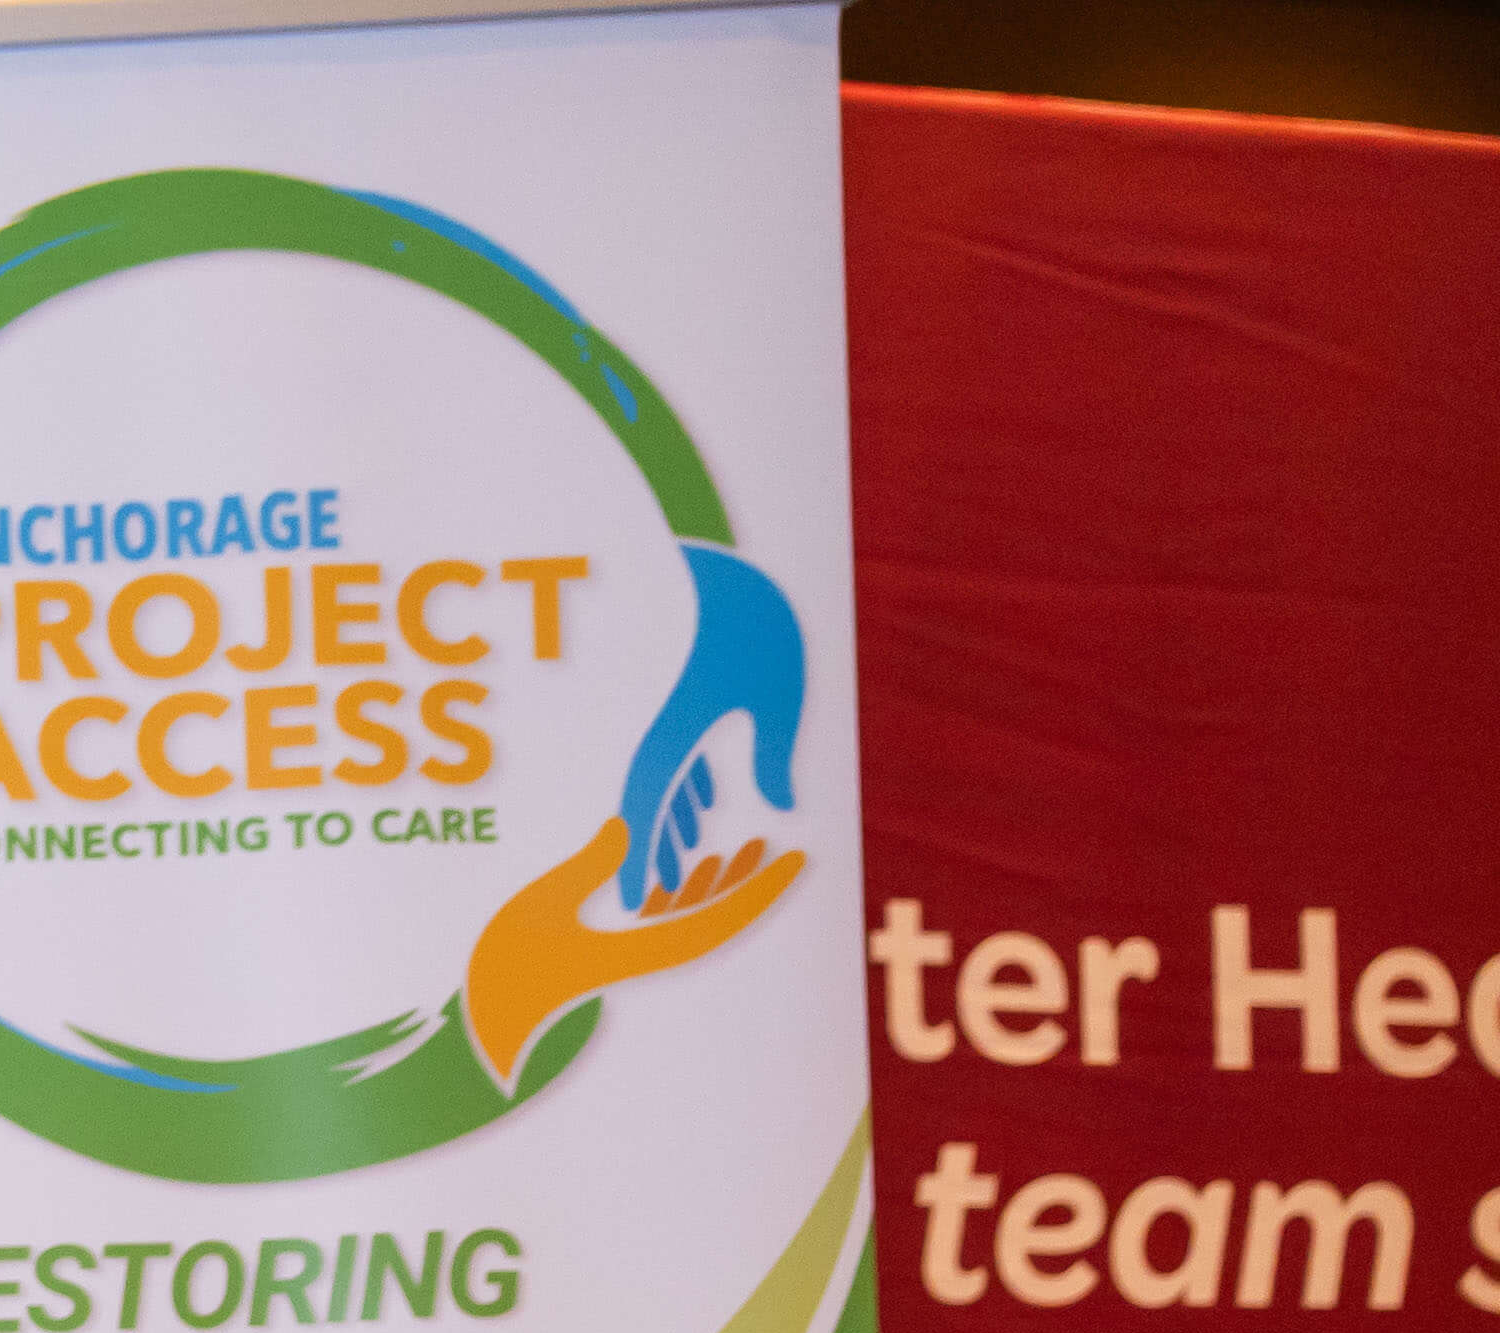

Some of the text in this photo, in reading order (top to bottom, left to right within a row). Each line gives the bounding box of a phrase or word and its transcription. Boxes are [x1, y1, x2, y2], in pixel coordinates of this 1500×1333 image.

[285, 811, 353, 848] TO
[372, 807, 497, 845] CARE
[915, 1142, 1415, 1311] team
